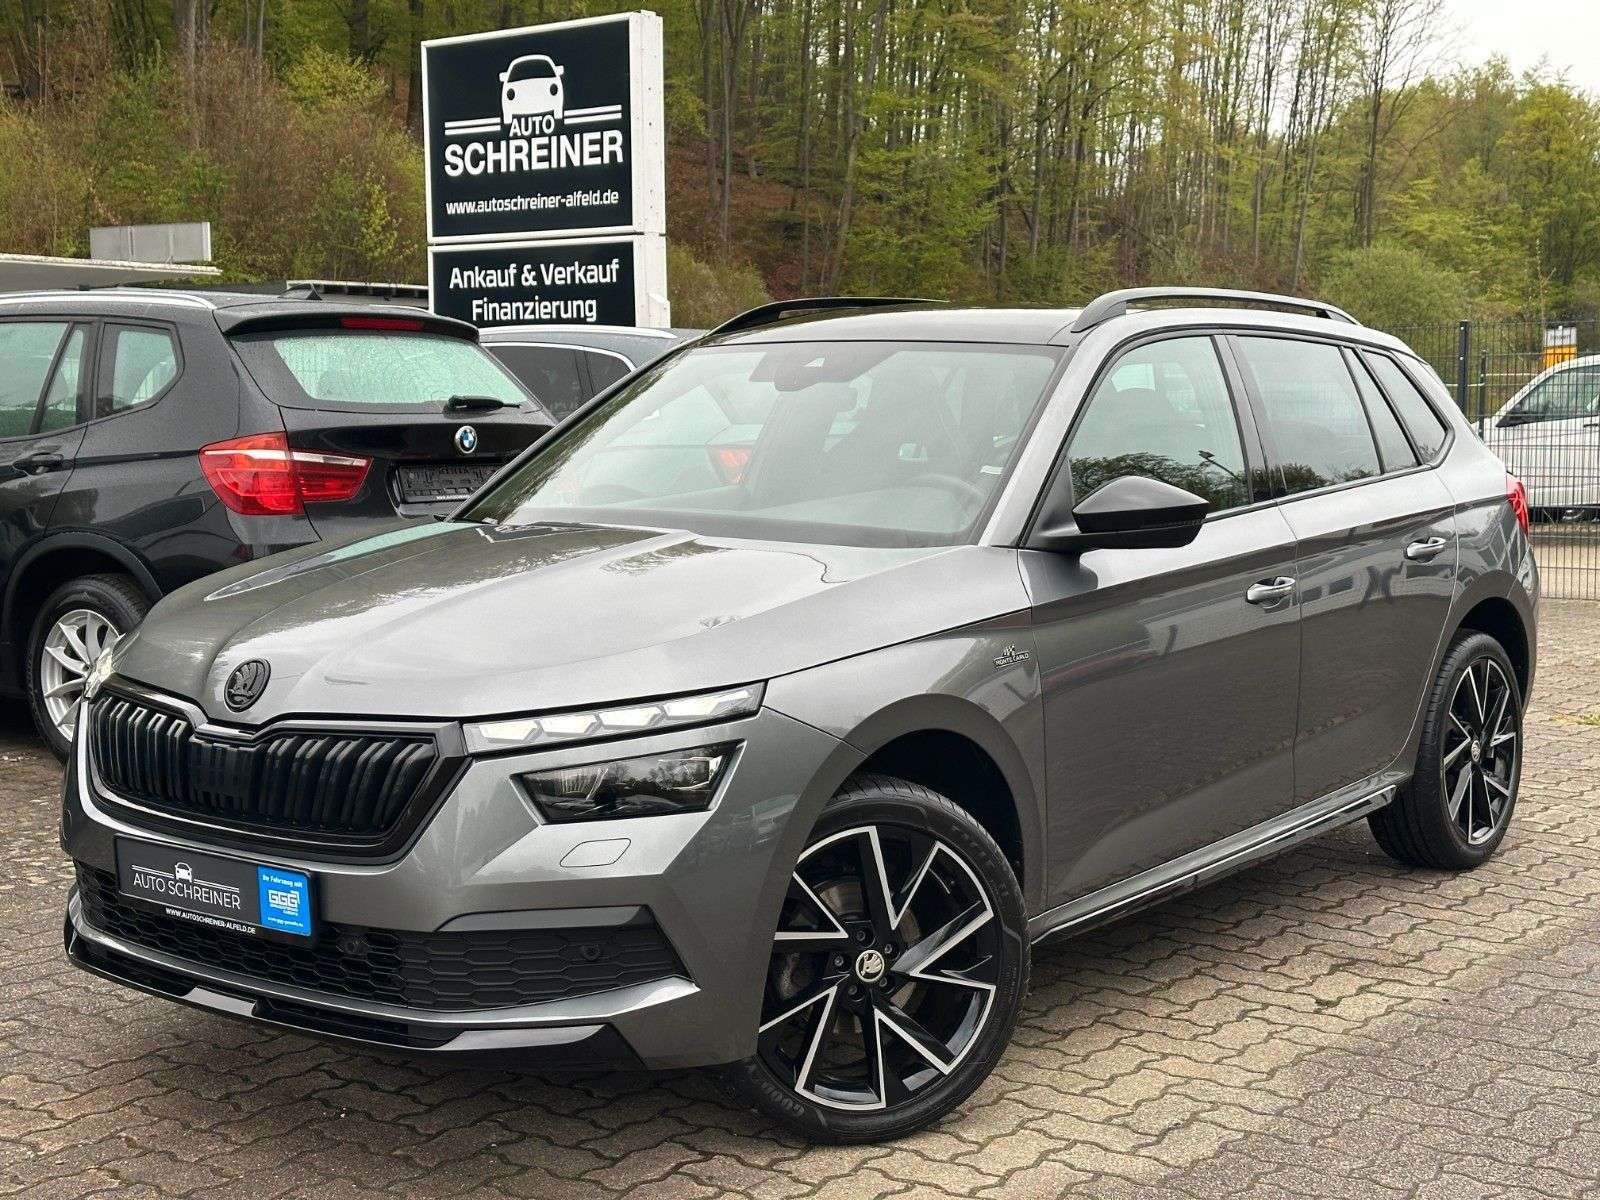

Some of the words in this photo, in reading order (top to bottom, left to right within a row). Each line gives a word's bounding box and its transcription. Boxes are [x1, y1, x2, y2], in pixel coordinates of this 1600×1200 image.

[509, 114, 555, 137] AUTO
[444, 129, 624, 177] SCHREINER
[446, 189, 619, 215] www.autoschreiner-alfeld.de
[449, 263, 517, 289] Ankauf
[521, 264, 537, 288] &
[540, 258, 619, 286] Verkauf
[472, 295, 597, 322] Finanzierung
[133, 872, 166, 892] AUTO
[168, 881, 241, 910] SCHREINER
[165, 907, 256, 935] WWW.AUTOSCHREINER-ALFELD.DE
